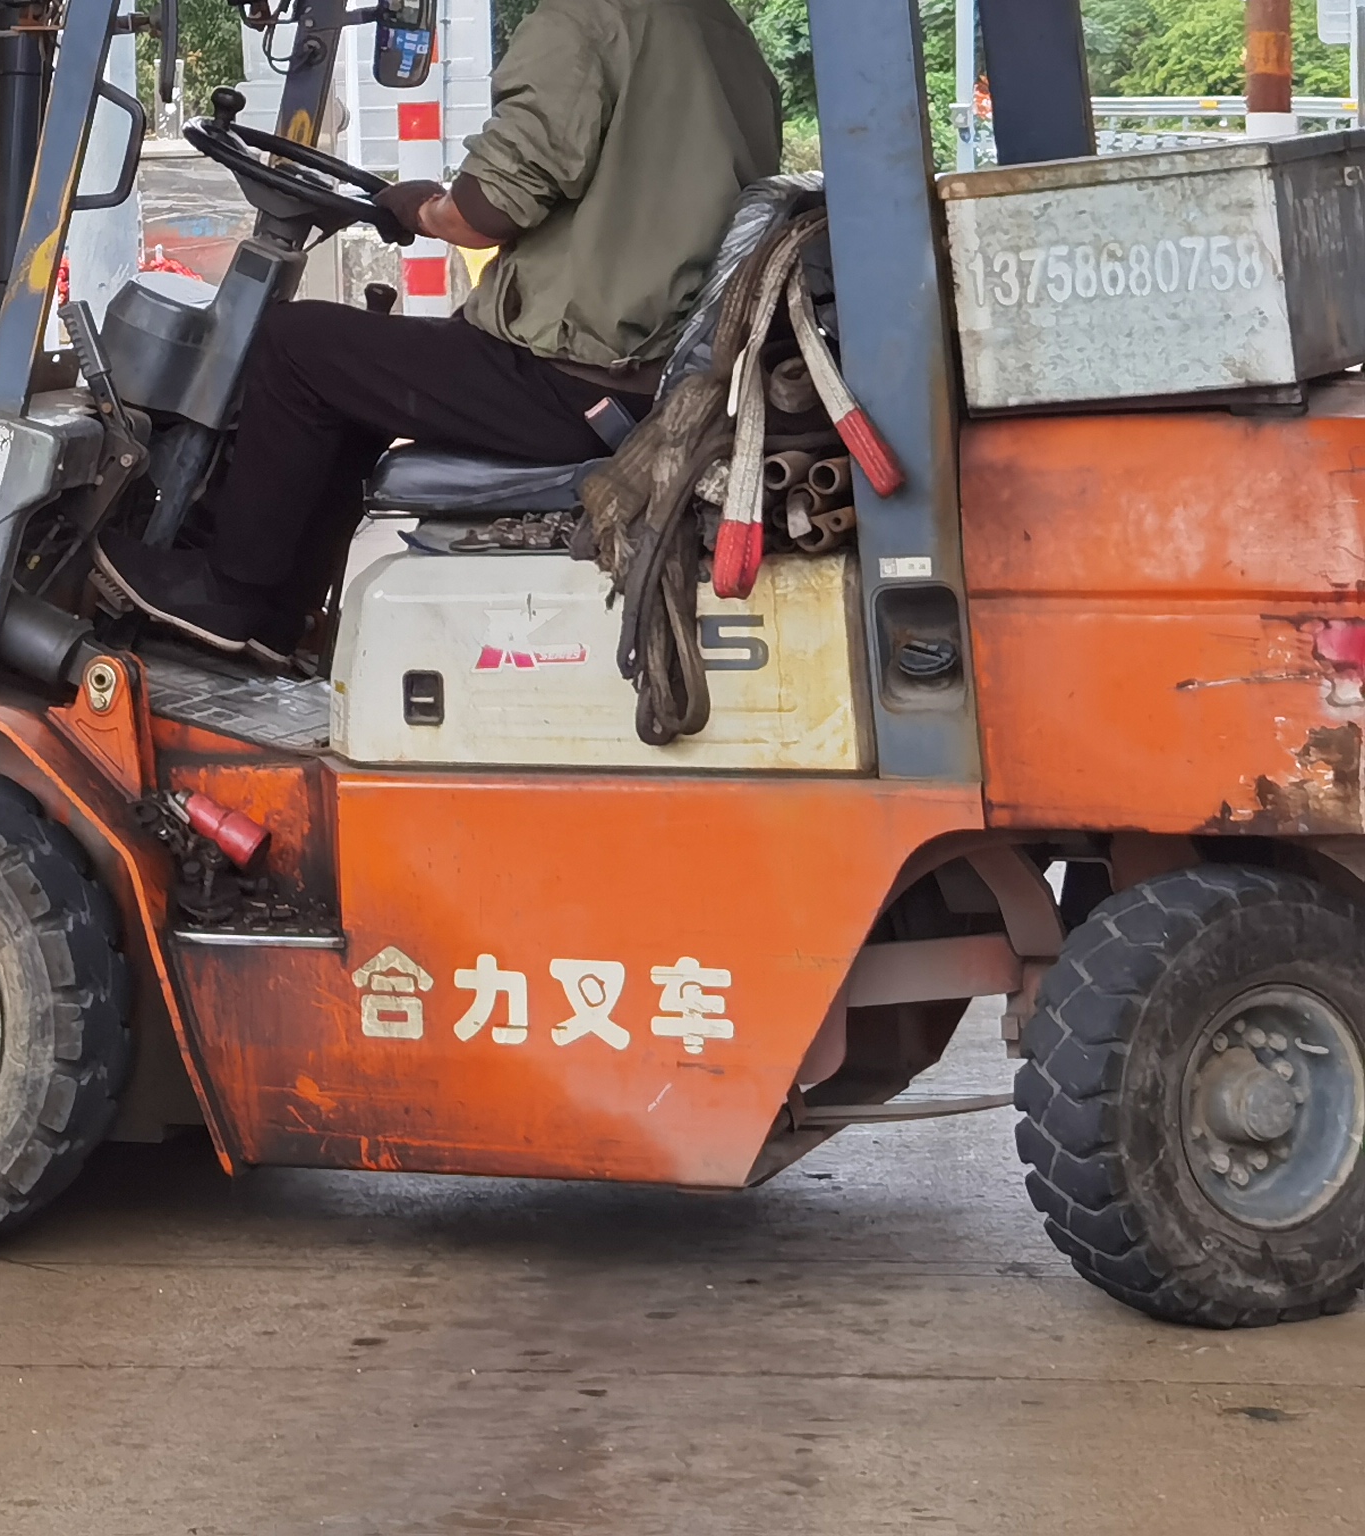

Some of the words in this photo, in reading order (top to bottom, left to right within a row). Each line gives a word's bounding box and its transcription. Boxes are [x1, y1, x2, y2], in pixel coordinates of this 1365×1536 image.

[967, 235, 1264, 307] 13758680758
[352, 945, 734, 1054] 合力叉车
